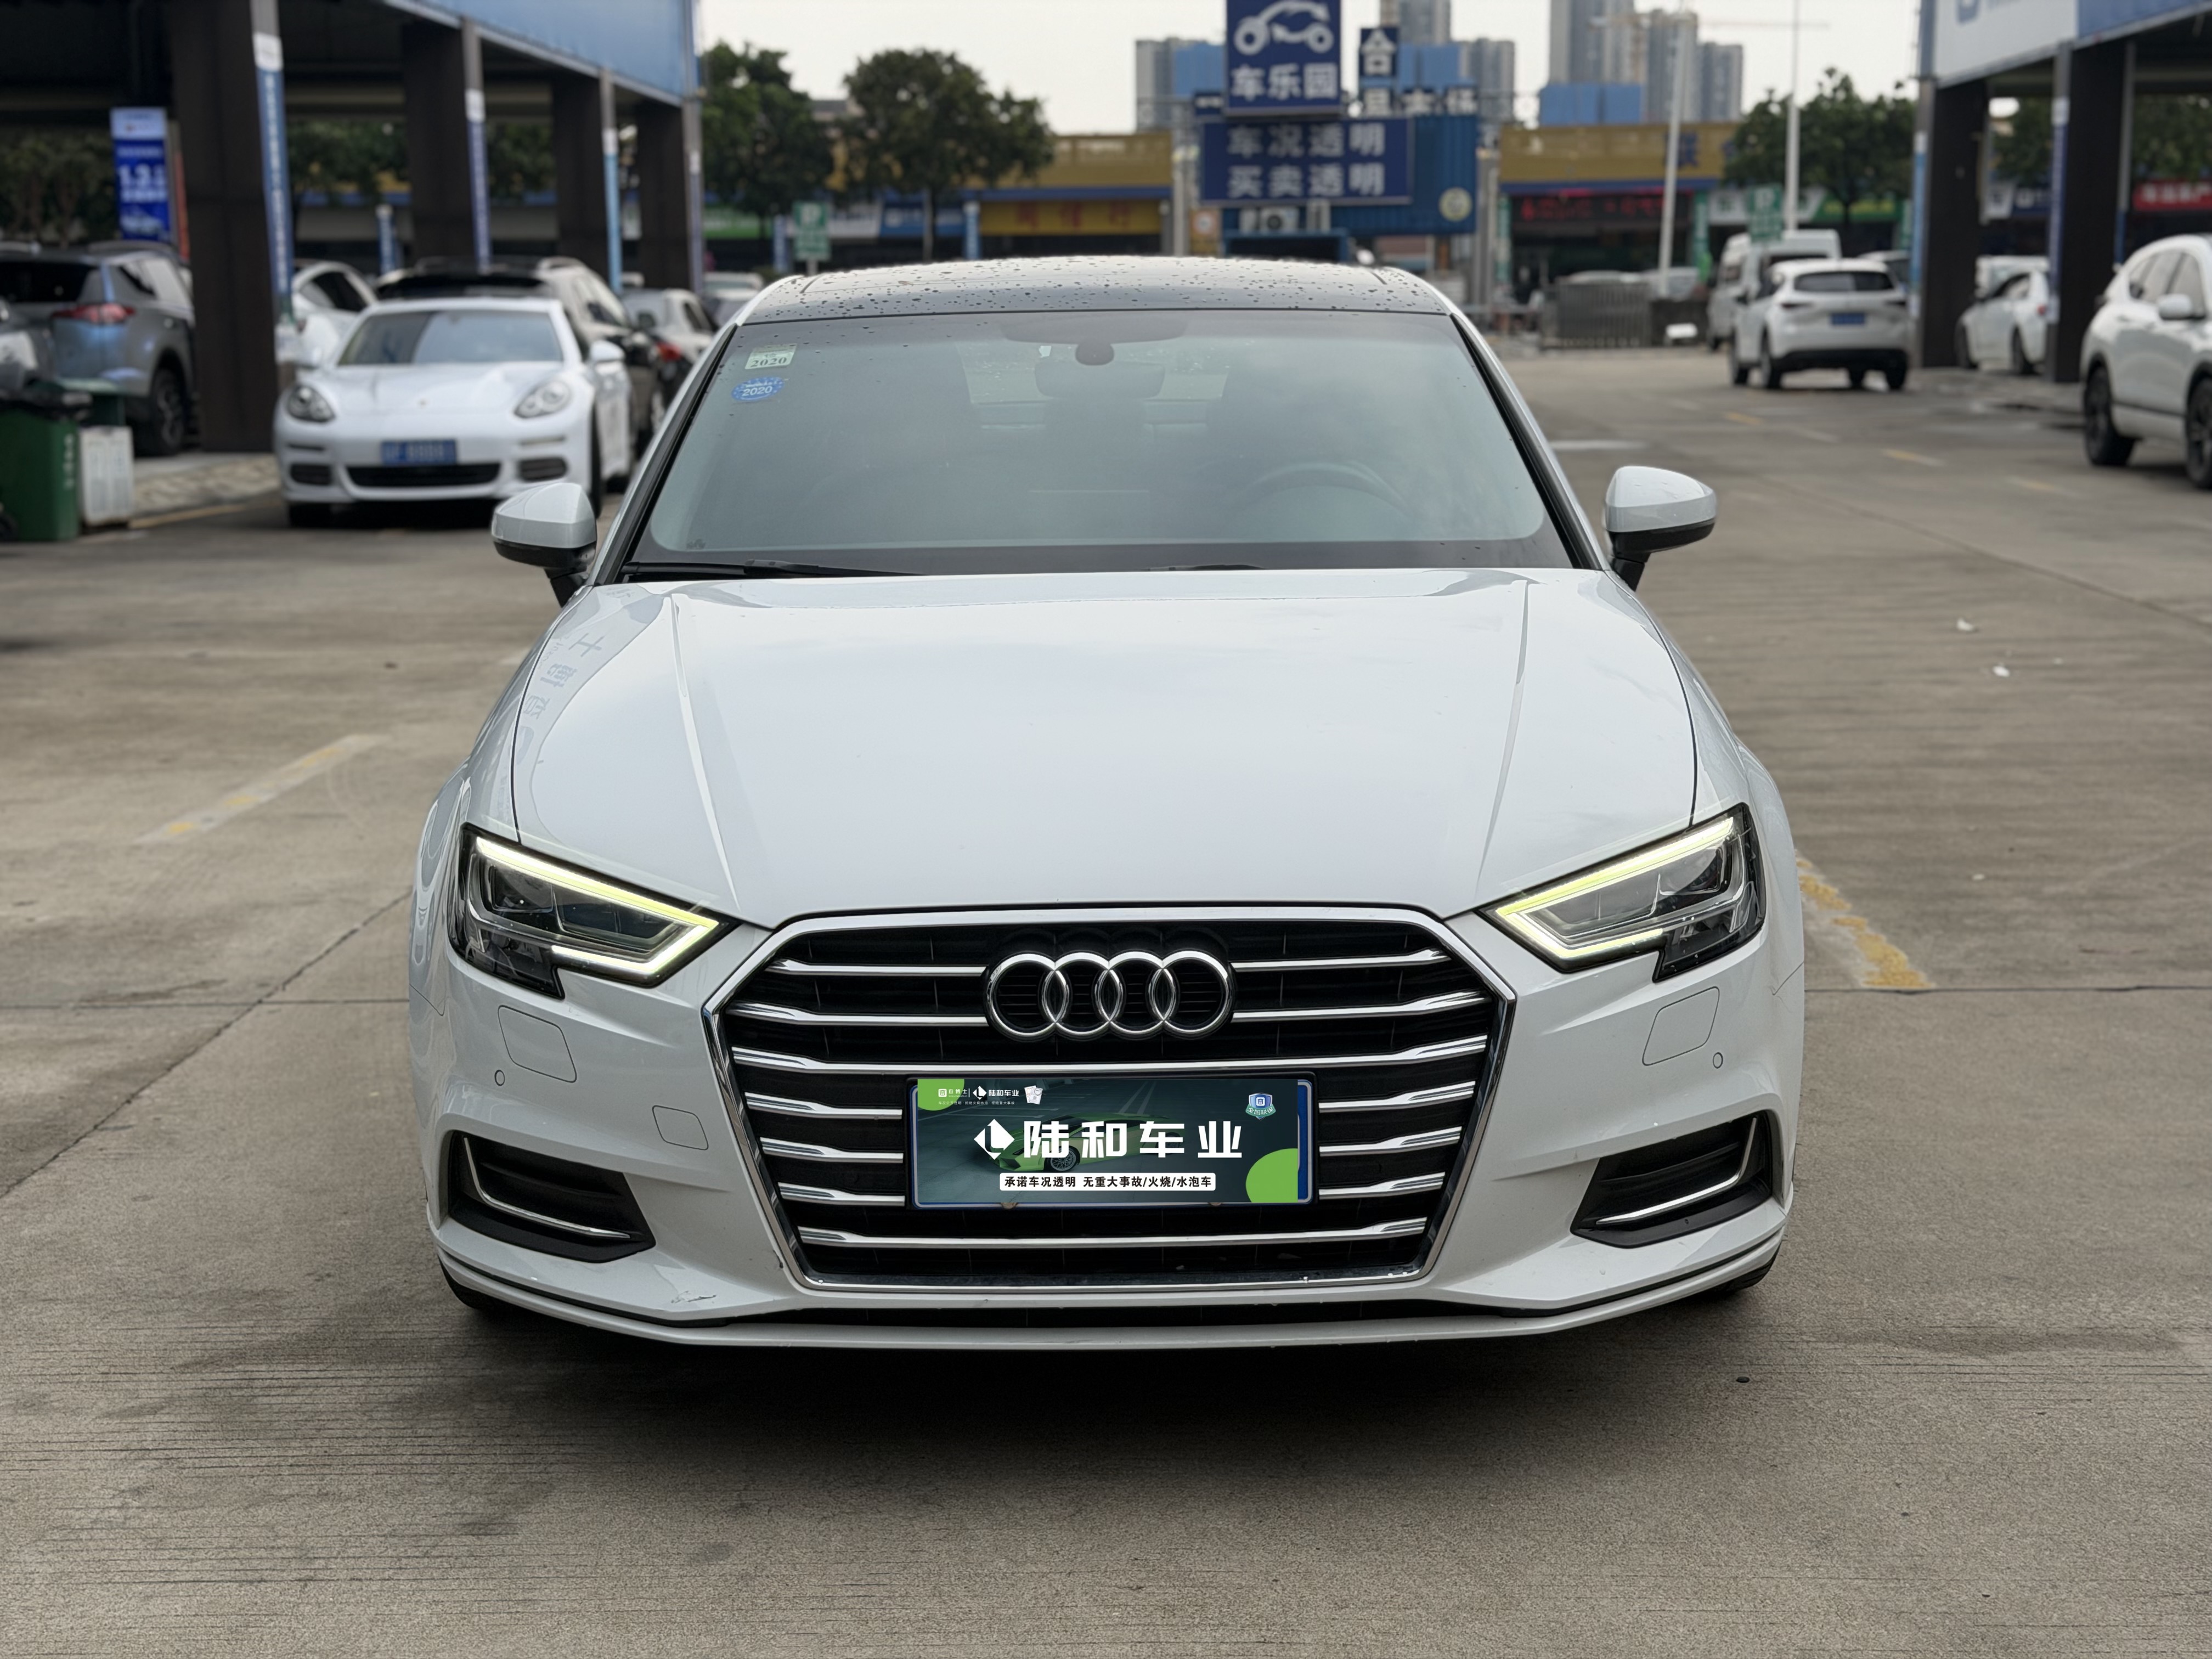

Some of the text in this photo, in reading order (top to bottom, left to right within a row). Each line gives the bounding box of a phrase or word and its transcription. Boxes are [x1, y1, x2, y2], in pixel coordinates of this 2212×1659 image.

[1232, 63, 1338, 100] 车乐园
[1227, 123, 1385, 158] 车况透明
[1227, 162, 1385, 197] 买卖透明
[751, 357, 787, 368] 2020
[742, 385, 773, 397] 2020
